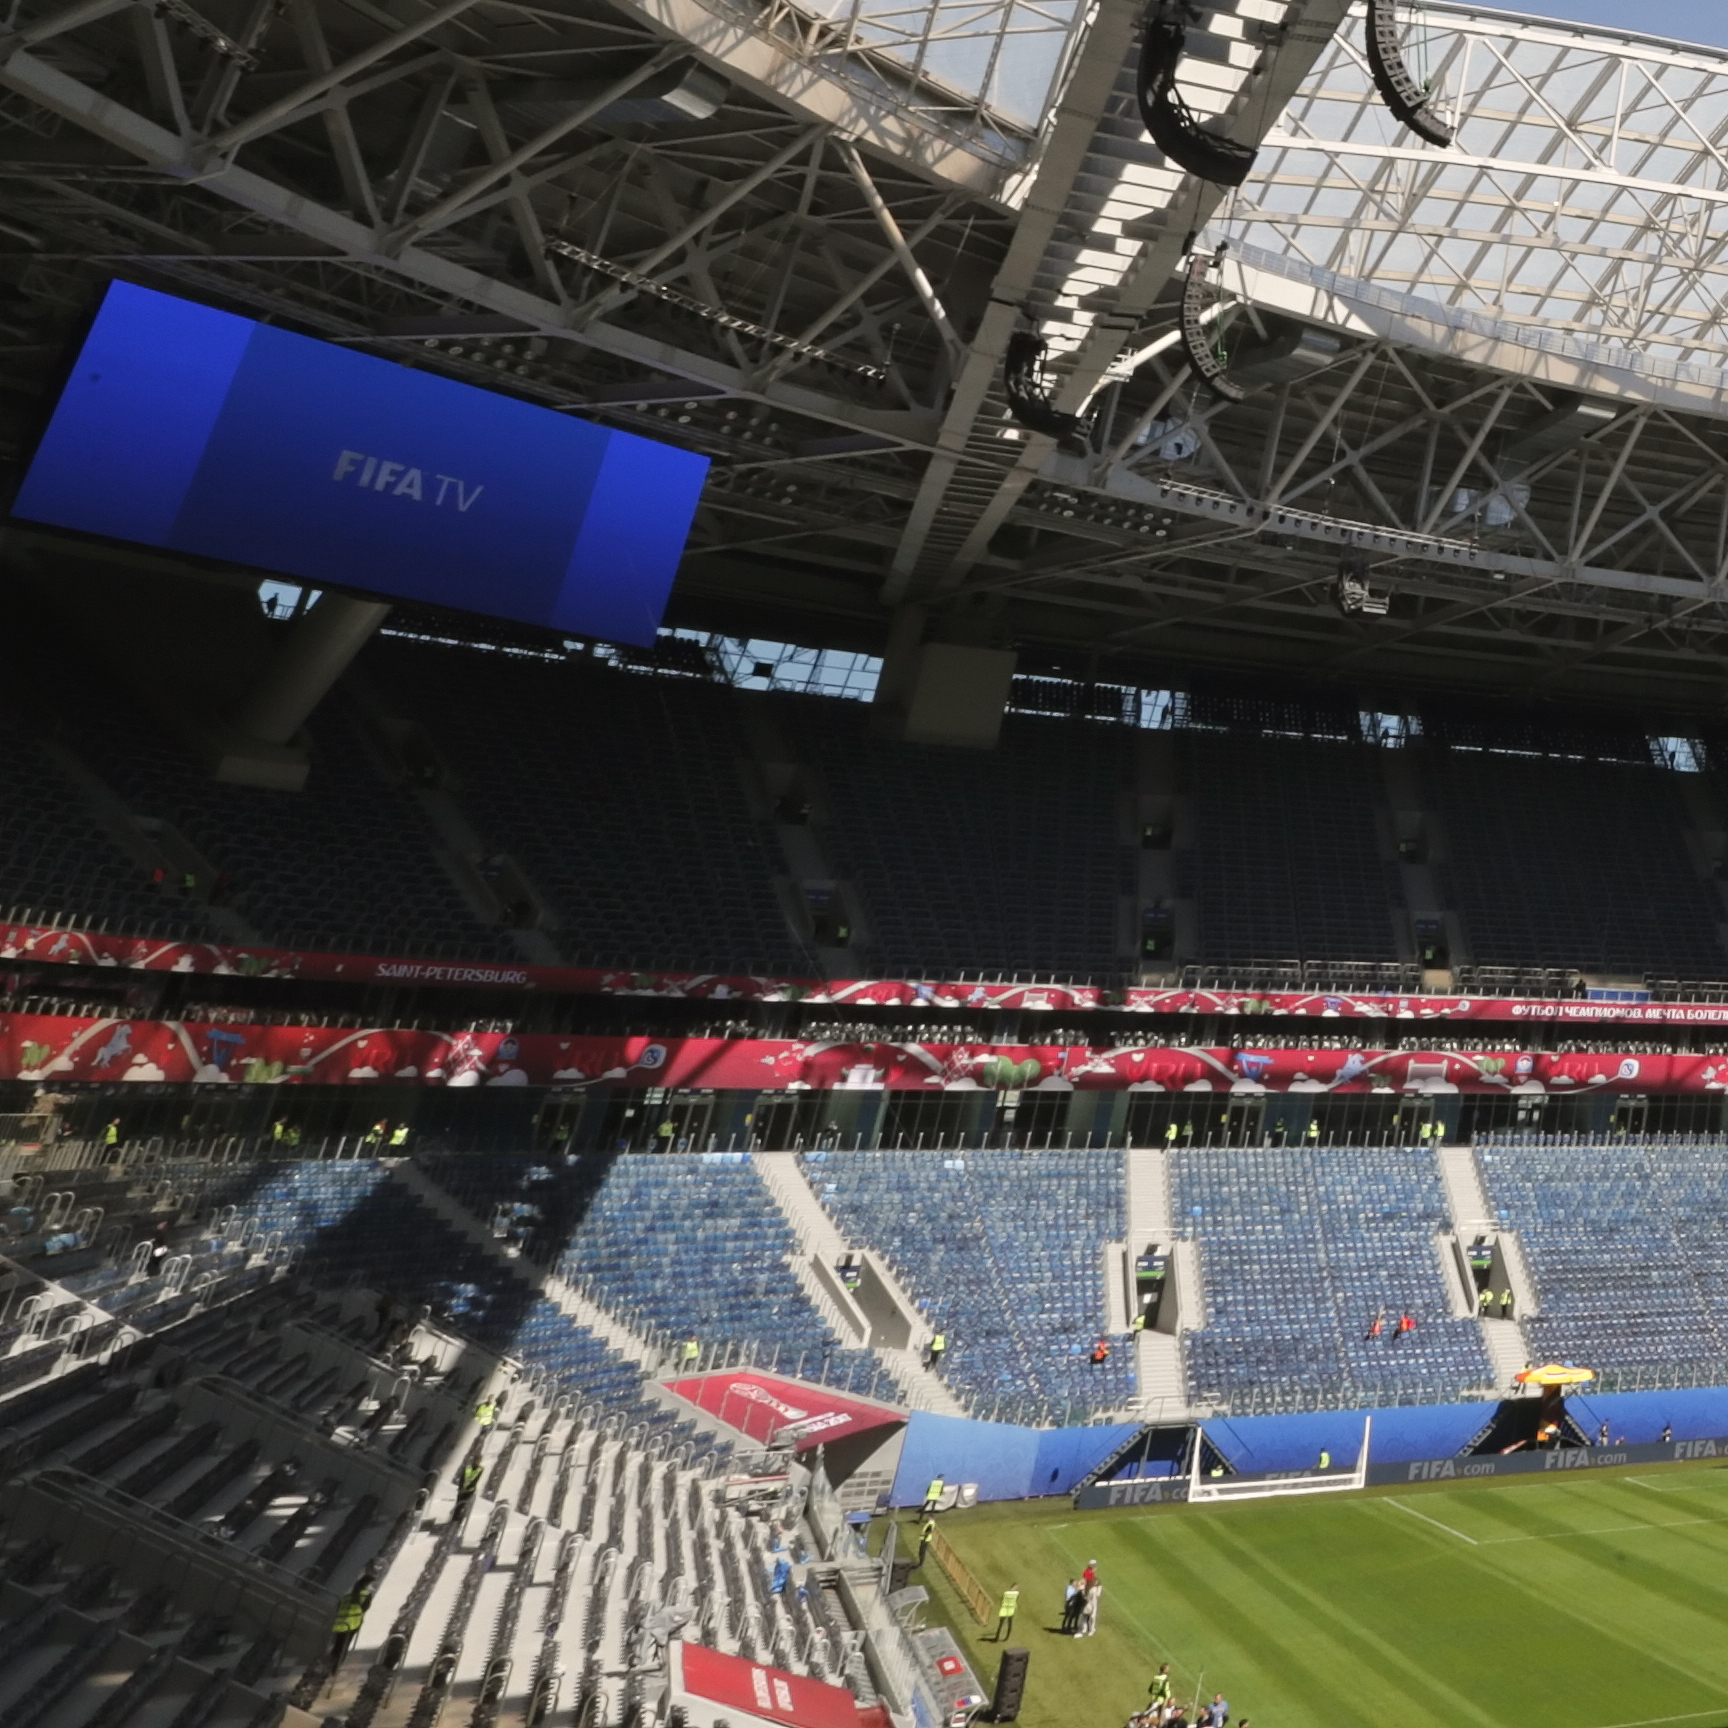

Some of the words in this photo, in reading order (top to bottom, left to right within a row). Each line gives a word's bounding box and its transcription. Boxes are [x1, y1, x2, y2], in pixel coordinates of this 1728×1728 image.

[332, 449, 423, 502] FIFA
[435, 473, 485, 512] TV
[376, 963, 527, 984] SAINT-PETERSBURG
[1512, 1005, 1562, 1016] ФУТБОЛ
[1544, 1448, 1627, 1469] FIFA.com
[1408, 1459, 1495, 1480] FIFA.com
[1109, 1483, 1188, 1505] FIFA.co
